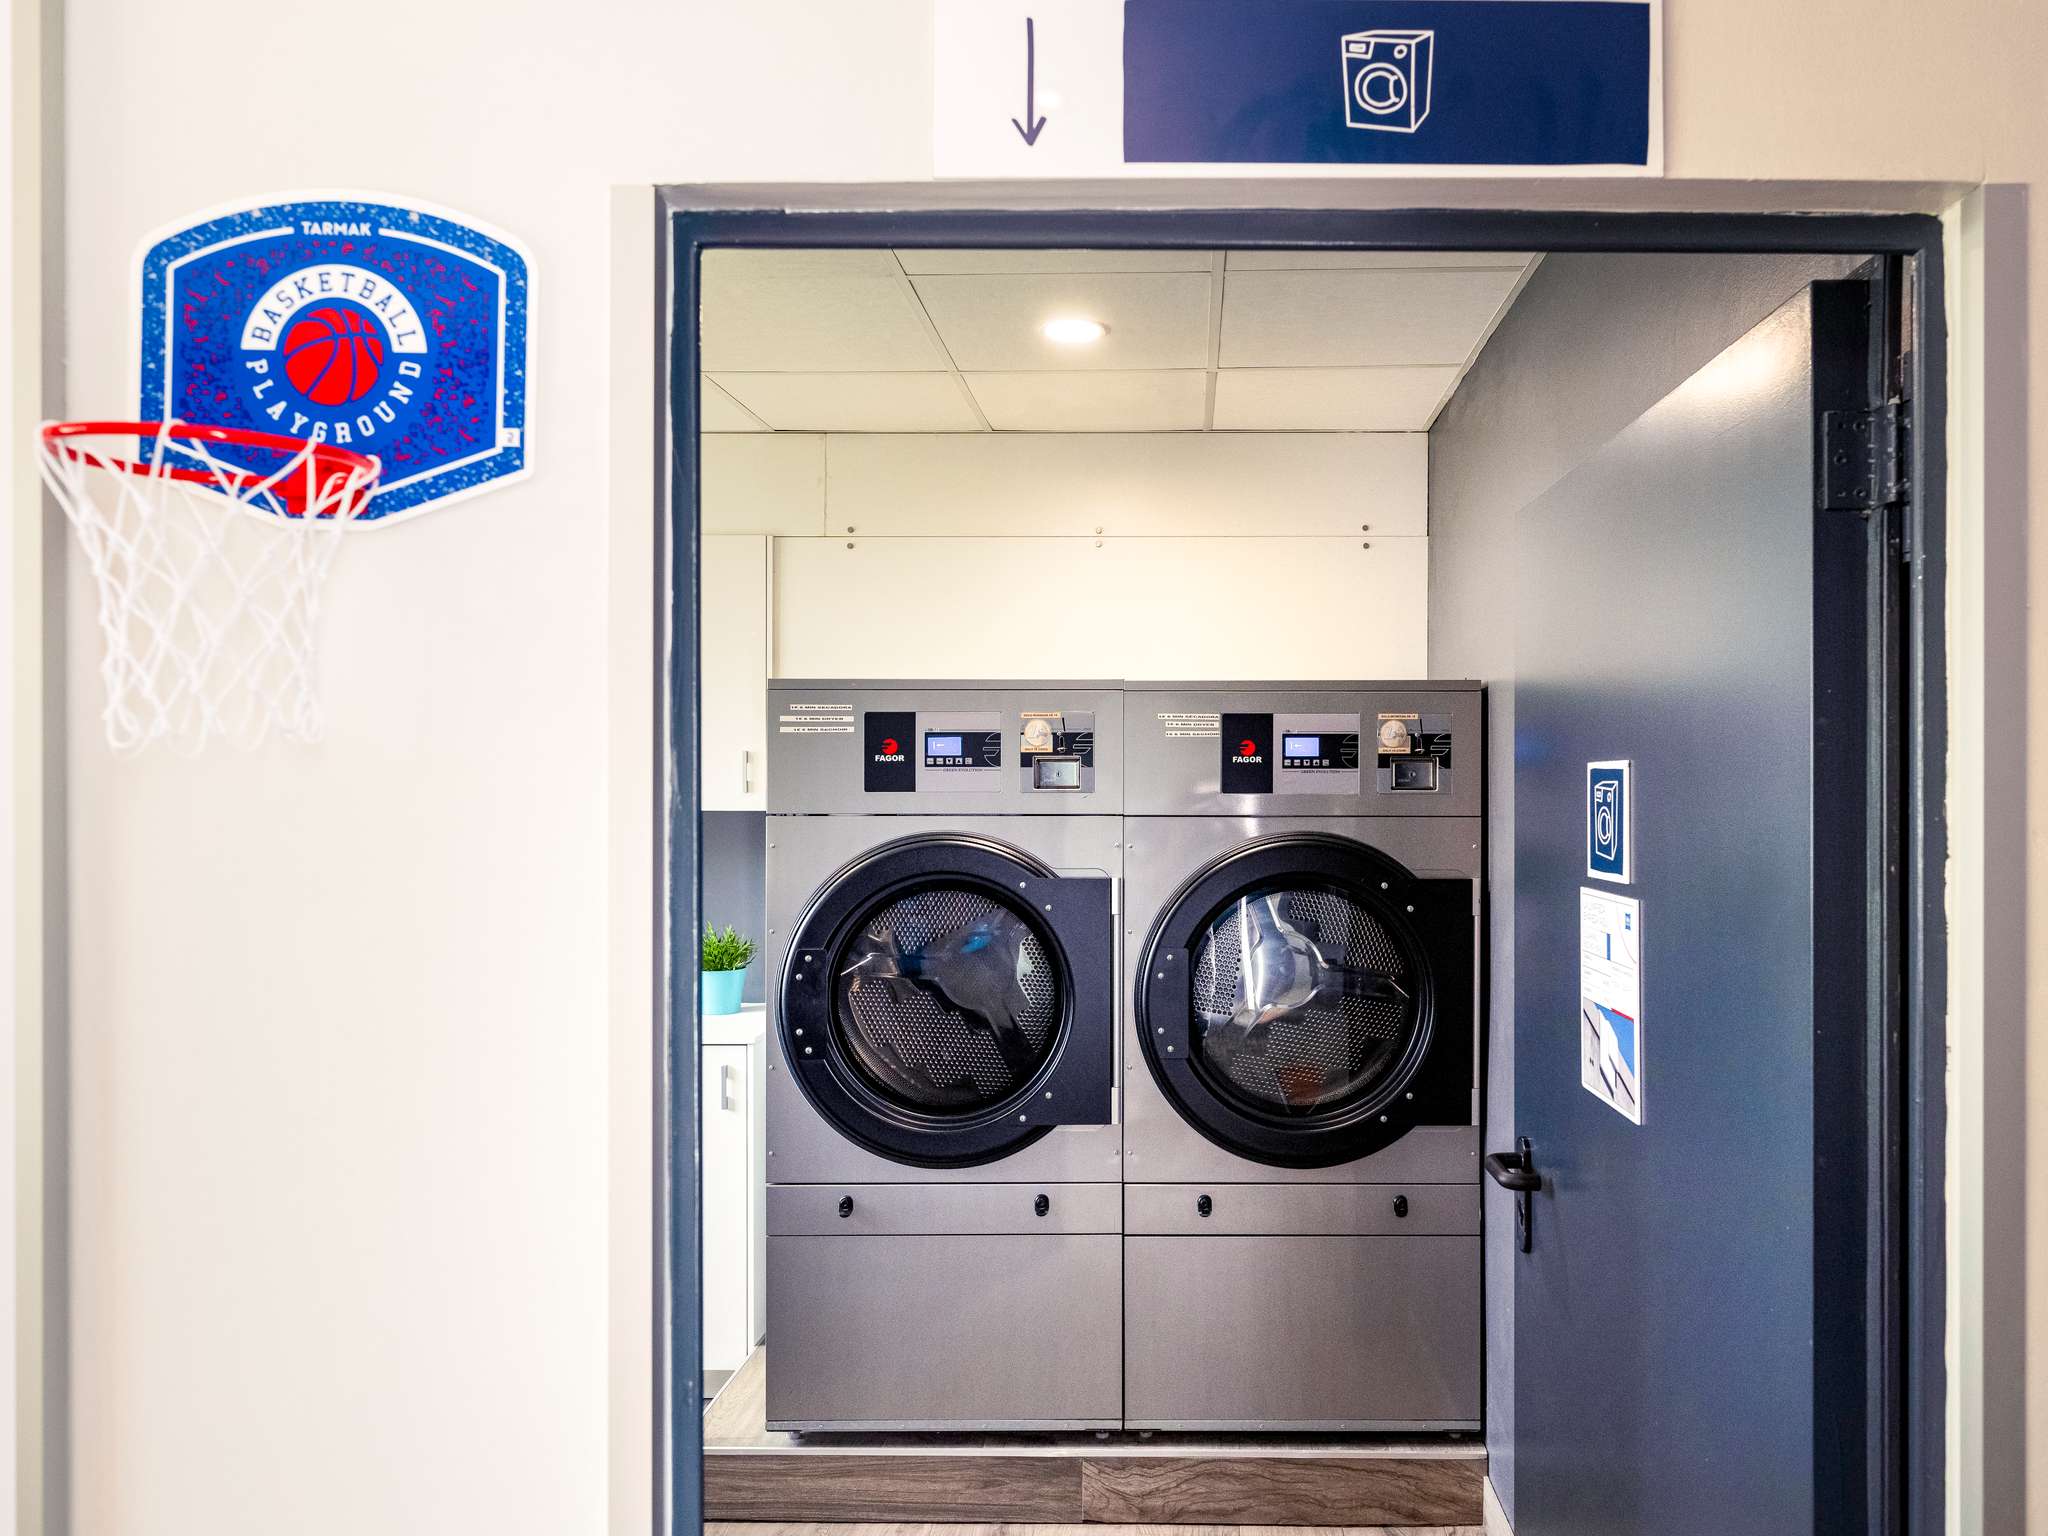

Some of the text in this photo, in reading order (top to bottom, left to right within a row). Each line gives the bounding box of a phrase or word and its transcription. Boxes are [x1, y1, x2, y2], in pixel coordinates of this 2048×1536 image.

[301, 221, 372, 236] TARMAK
[252, 272, 416, 346] BASKETBALL
[245, 358, 422, 443] PLAYGROUND
[875, 754, 905, 762] FAGOR
